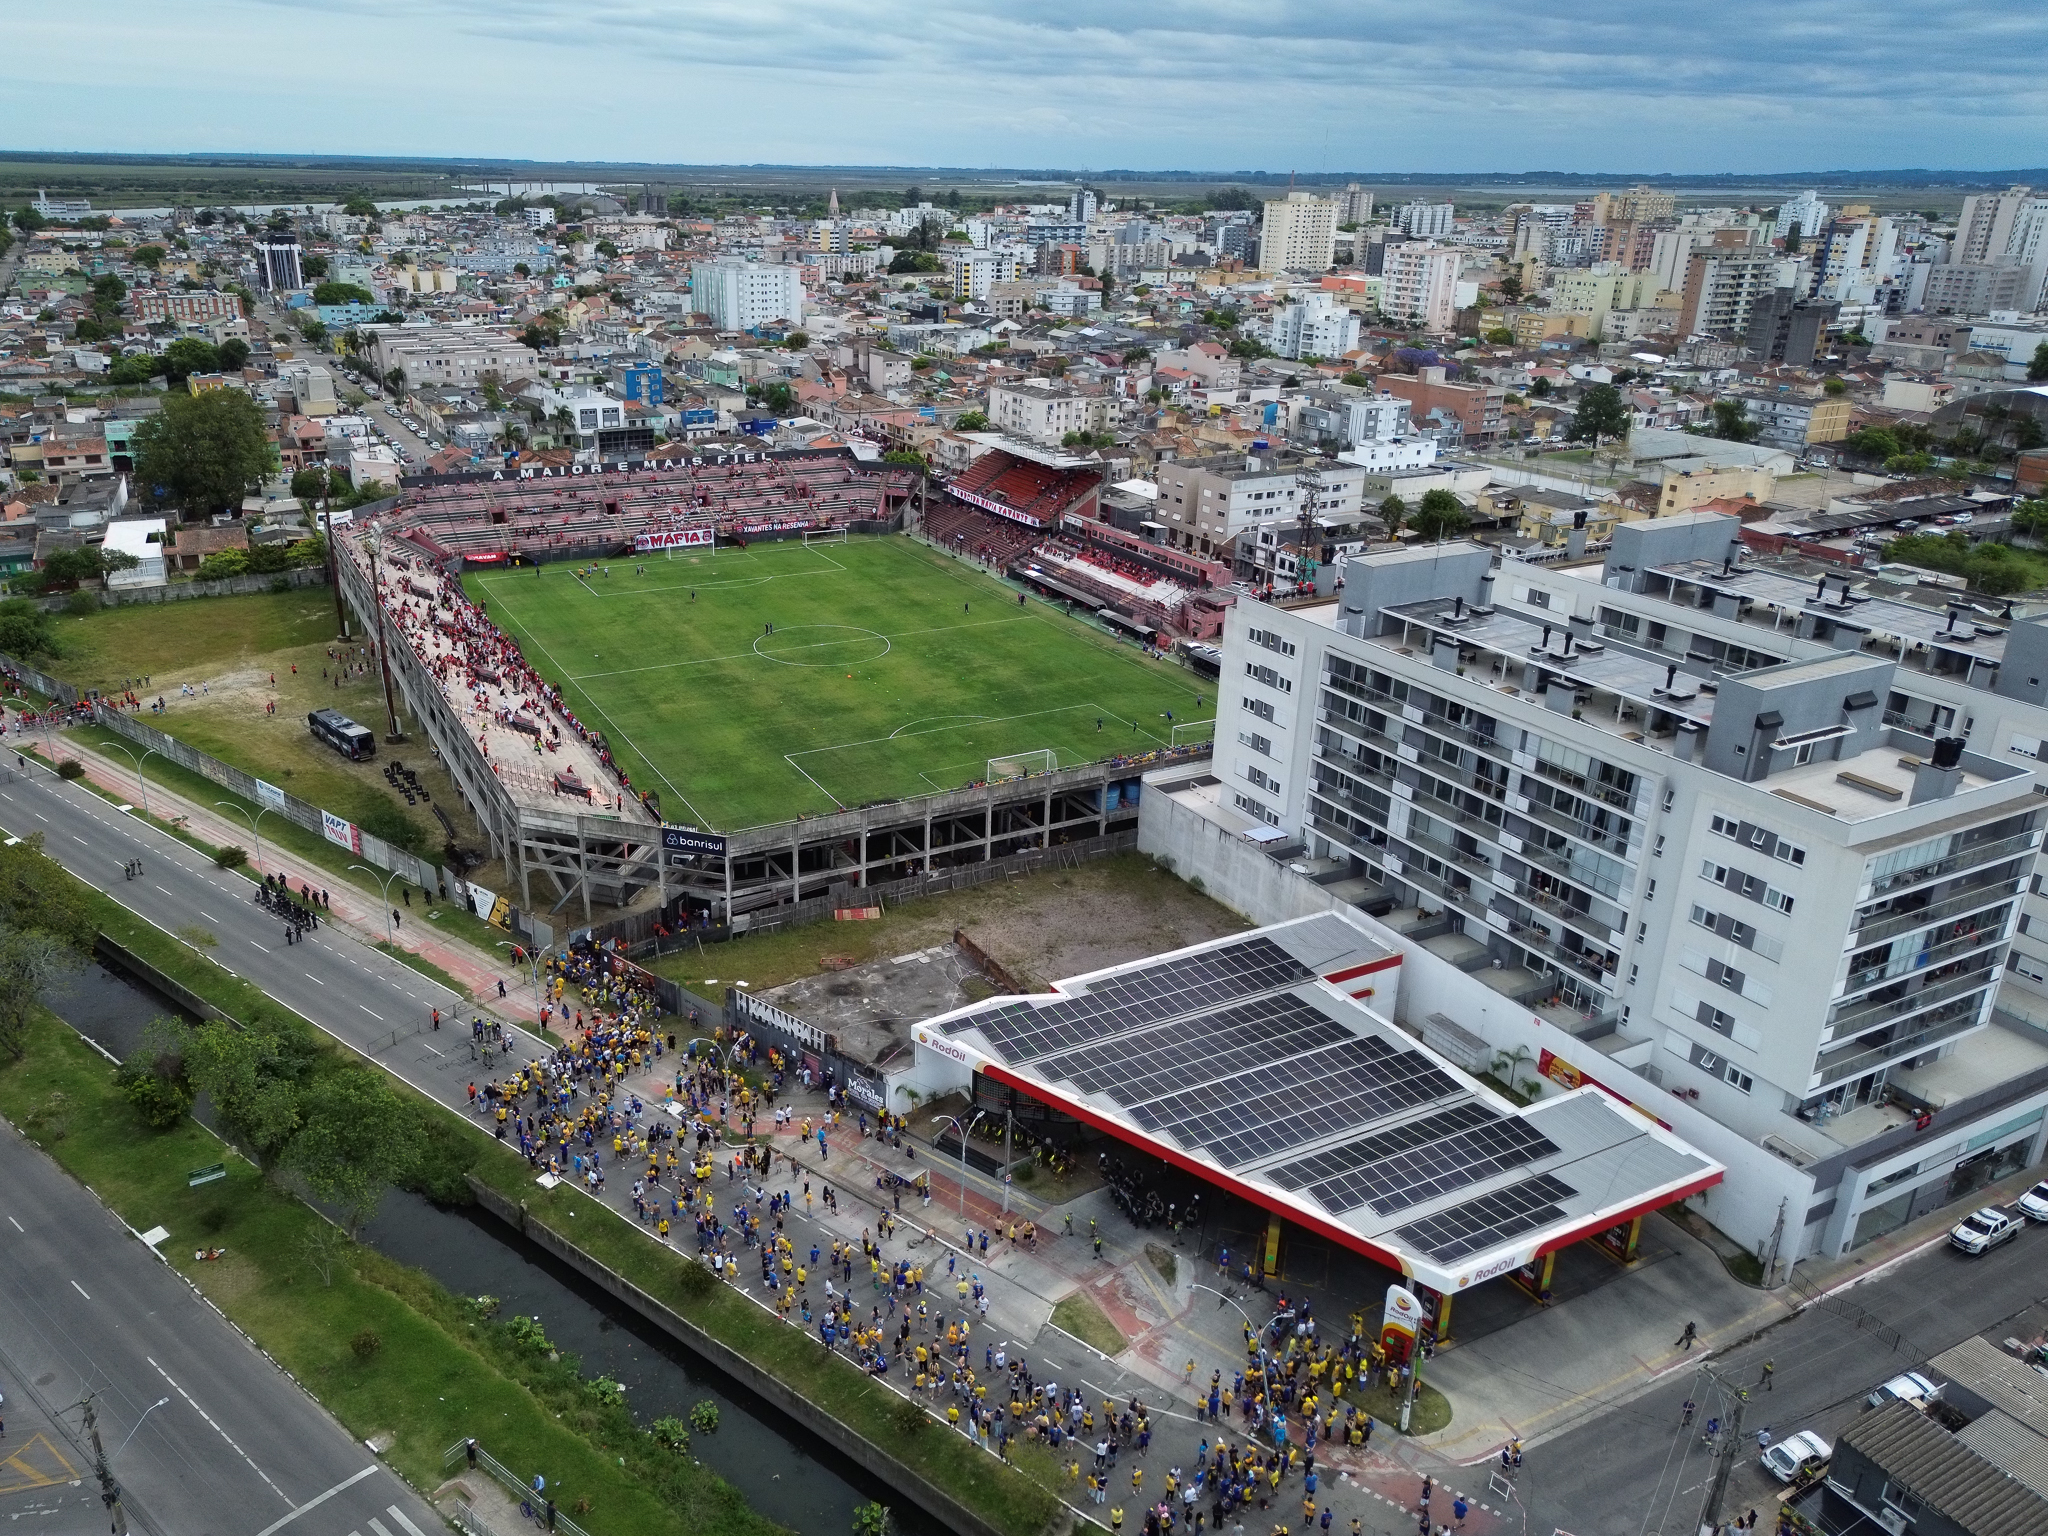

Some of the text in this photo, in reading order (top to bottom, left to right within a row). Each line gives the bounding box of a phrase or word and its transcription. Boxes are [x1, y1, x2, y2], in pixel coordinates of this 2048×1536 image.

[493, 452, 772, 480] A MAIOR E MAIS FIEL
[743, 523, 773, 533] XAVANTES
[782, 520, 809, 530] RESENHA
[325, 815, 347, 831] VAPT
[680, 835, 723, 851] banrisul
[931, 1039, 966, 1062] RodOil
[848, 1078, 884, 1104] Morales
[1474, 1256, 1516, 1282] RodOil
[1390, 1306, 1414, 1321] RodOil
